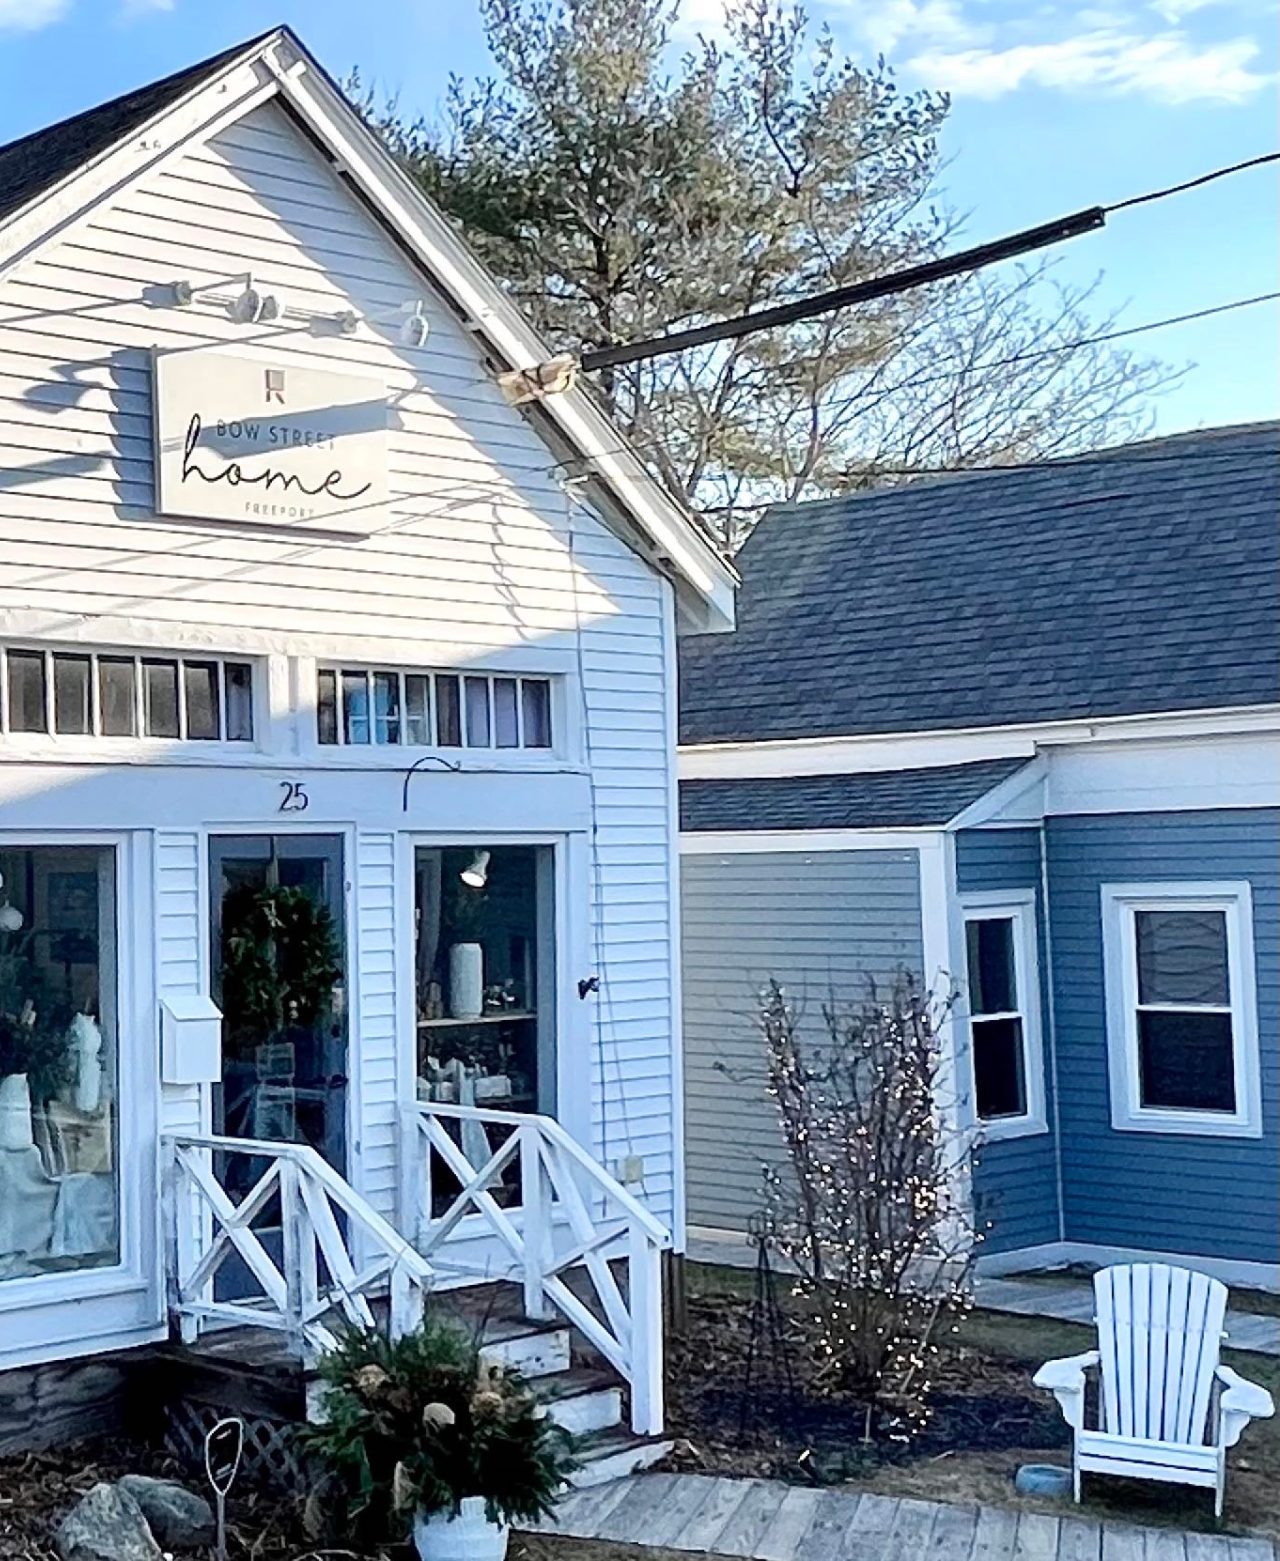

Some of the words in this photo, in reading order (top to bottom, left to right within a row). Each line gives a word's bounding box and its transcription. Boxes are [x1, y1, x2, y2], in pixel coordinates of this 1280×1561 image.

[216, 420, 260, 440] BOW
[269, 425, 336, 451] STREET
[182, 413, 372, 500] home
[244, 502, 315, 517] FREEPORT
[279, 781, 309, 812] 25
